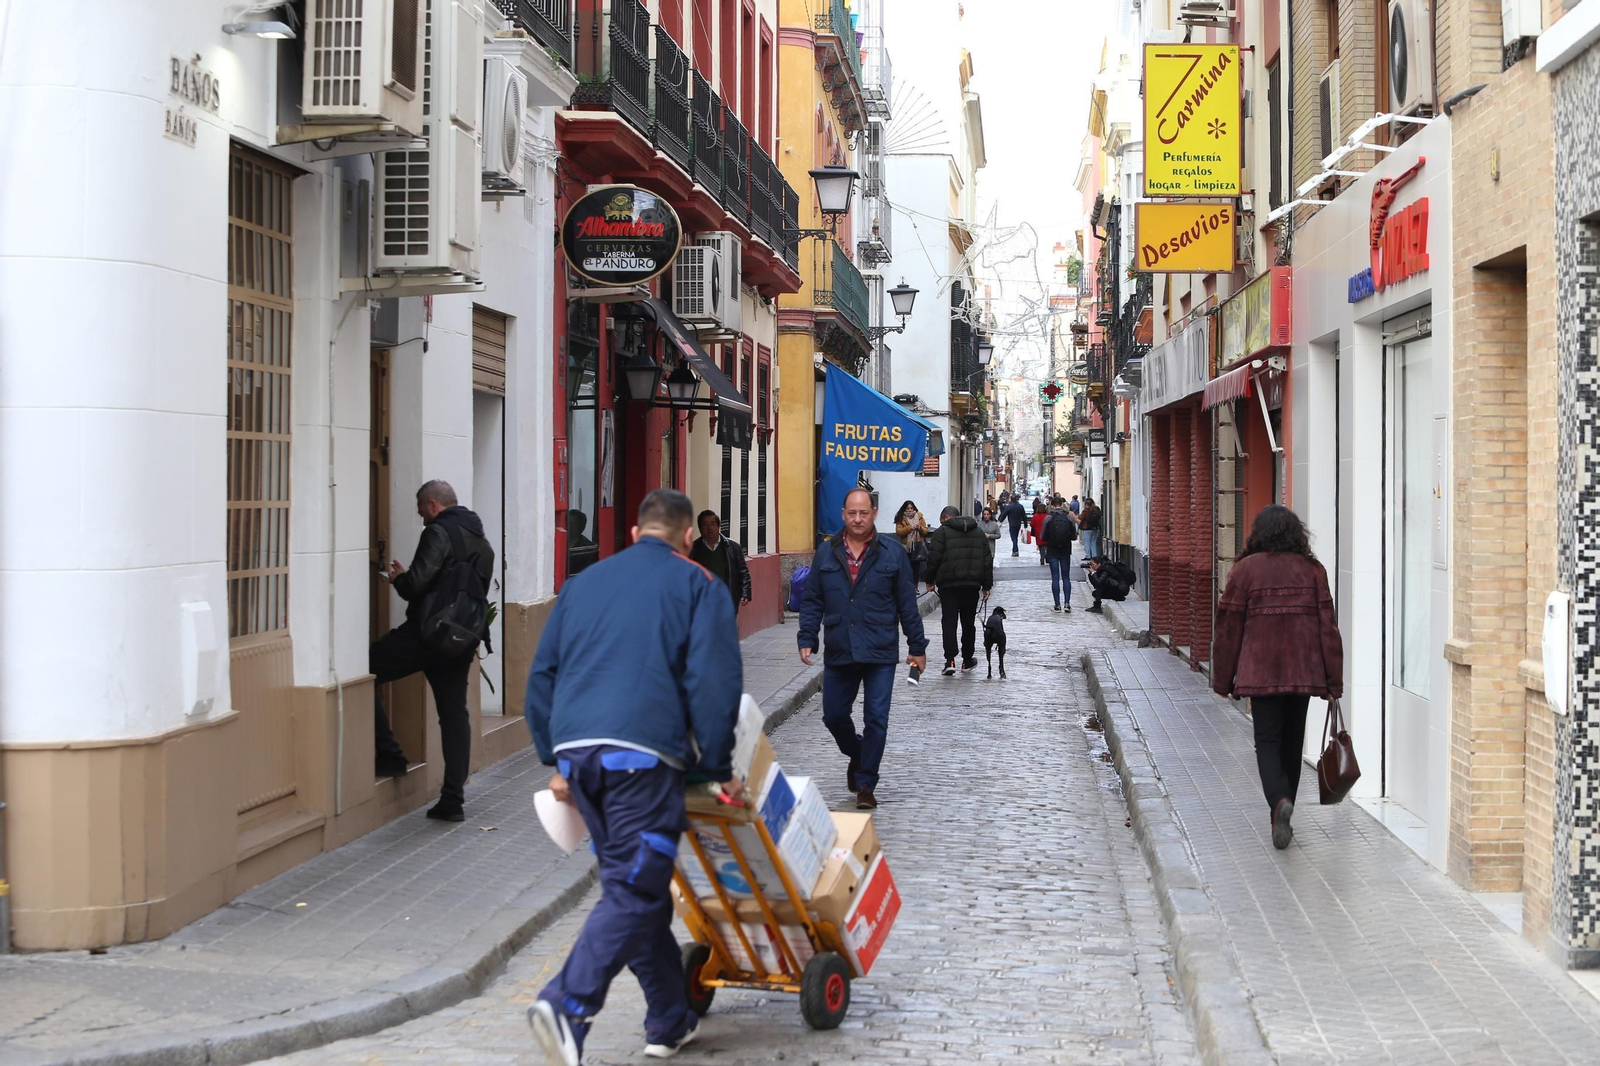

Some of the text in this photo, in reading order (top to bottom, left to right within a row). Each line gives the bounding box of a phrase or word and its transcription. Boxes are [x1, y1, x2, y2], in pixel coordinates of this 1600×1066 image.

[170, 54, 220, 111] BAÑOS
[1158, 53, 1231, 144] Carmina
[576, 216, 665, 239] Alhambra
[1142, 209, 1230, 268] Desavios
[595, 258, 656, 269] PANDURO
[835, 423, 902, 442] FRUTAS
[825, 441, 912, 463] FAUSTINO
